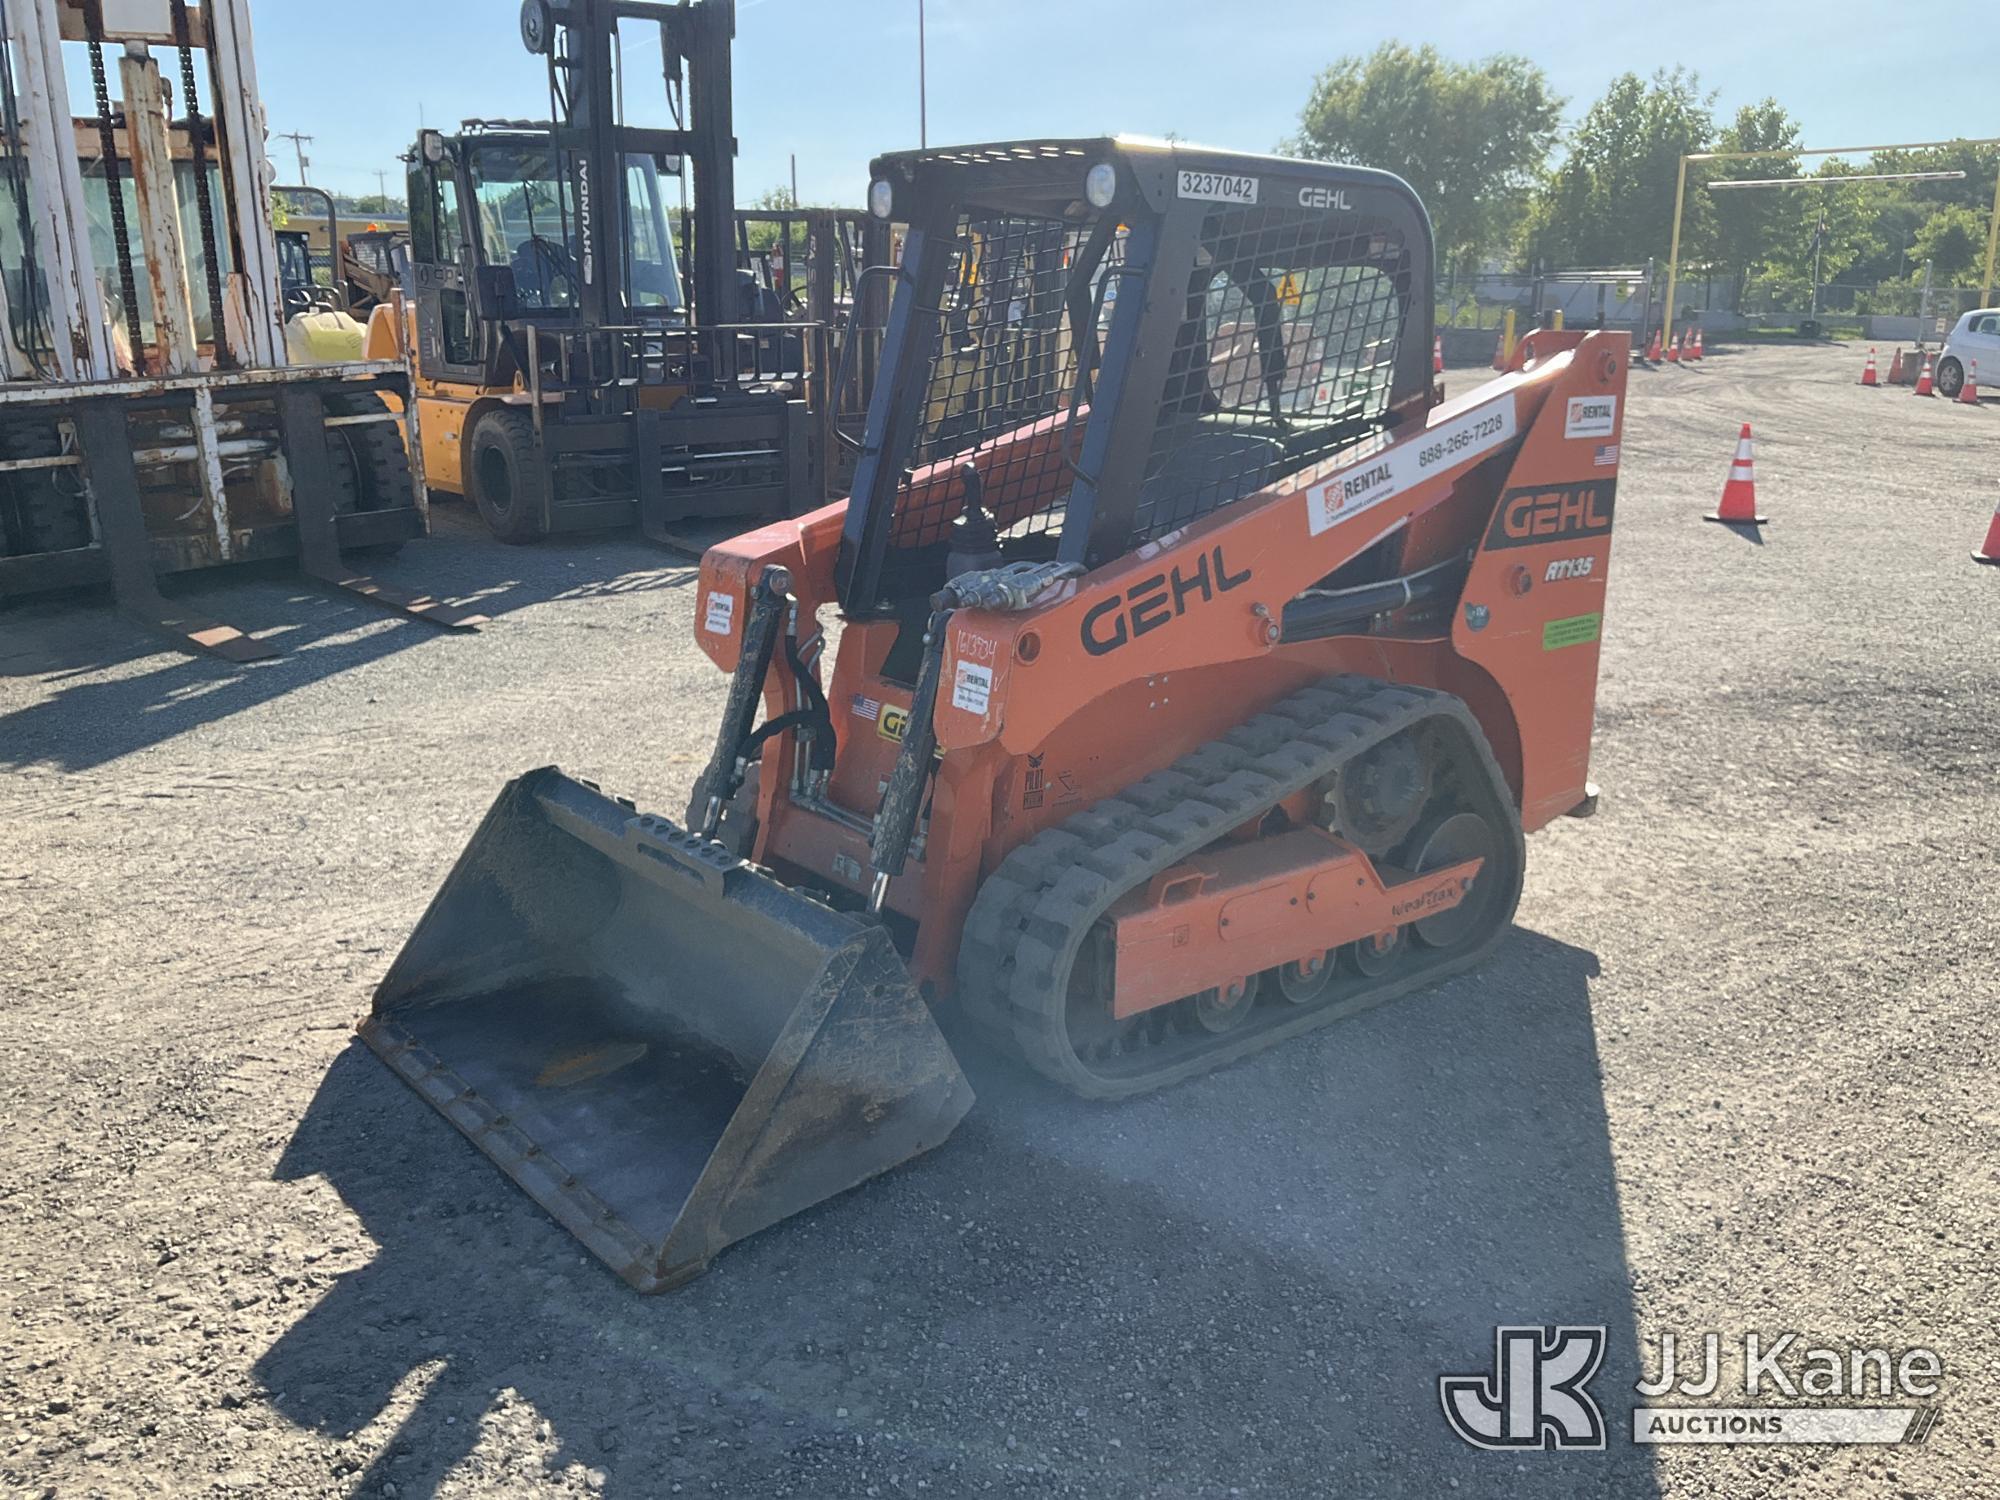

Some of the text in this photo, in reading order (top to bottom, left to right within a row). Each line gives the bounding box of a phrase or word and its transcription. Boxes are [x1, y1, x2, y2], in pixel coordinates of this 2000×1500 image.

[1182, 172, 1253, 198] 3237042
[1298, 186, 1352, 211] GEHL
[579, 160, 591, 254] HYUNDAI
[1582, 404, 1612, 419] RENTAL
[1418, 413, 1503, 468] 888-266-7228
[1343, 463, 1394, 500] RENTAL
[1503, 489, 1608, 539] GEHL
[1543, 556, 1596, 582] RT135
[1080, 544, 1252, 657] GEHL
